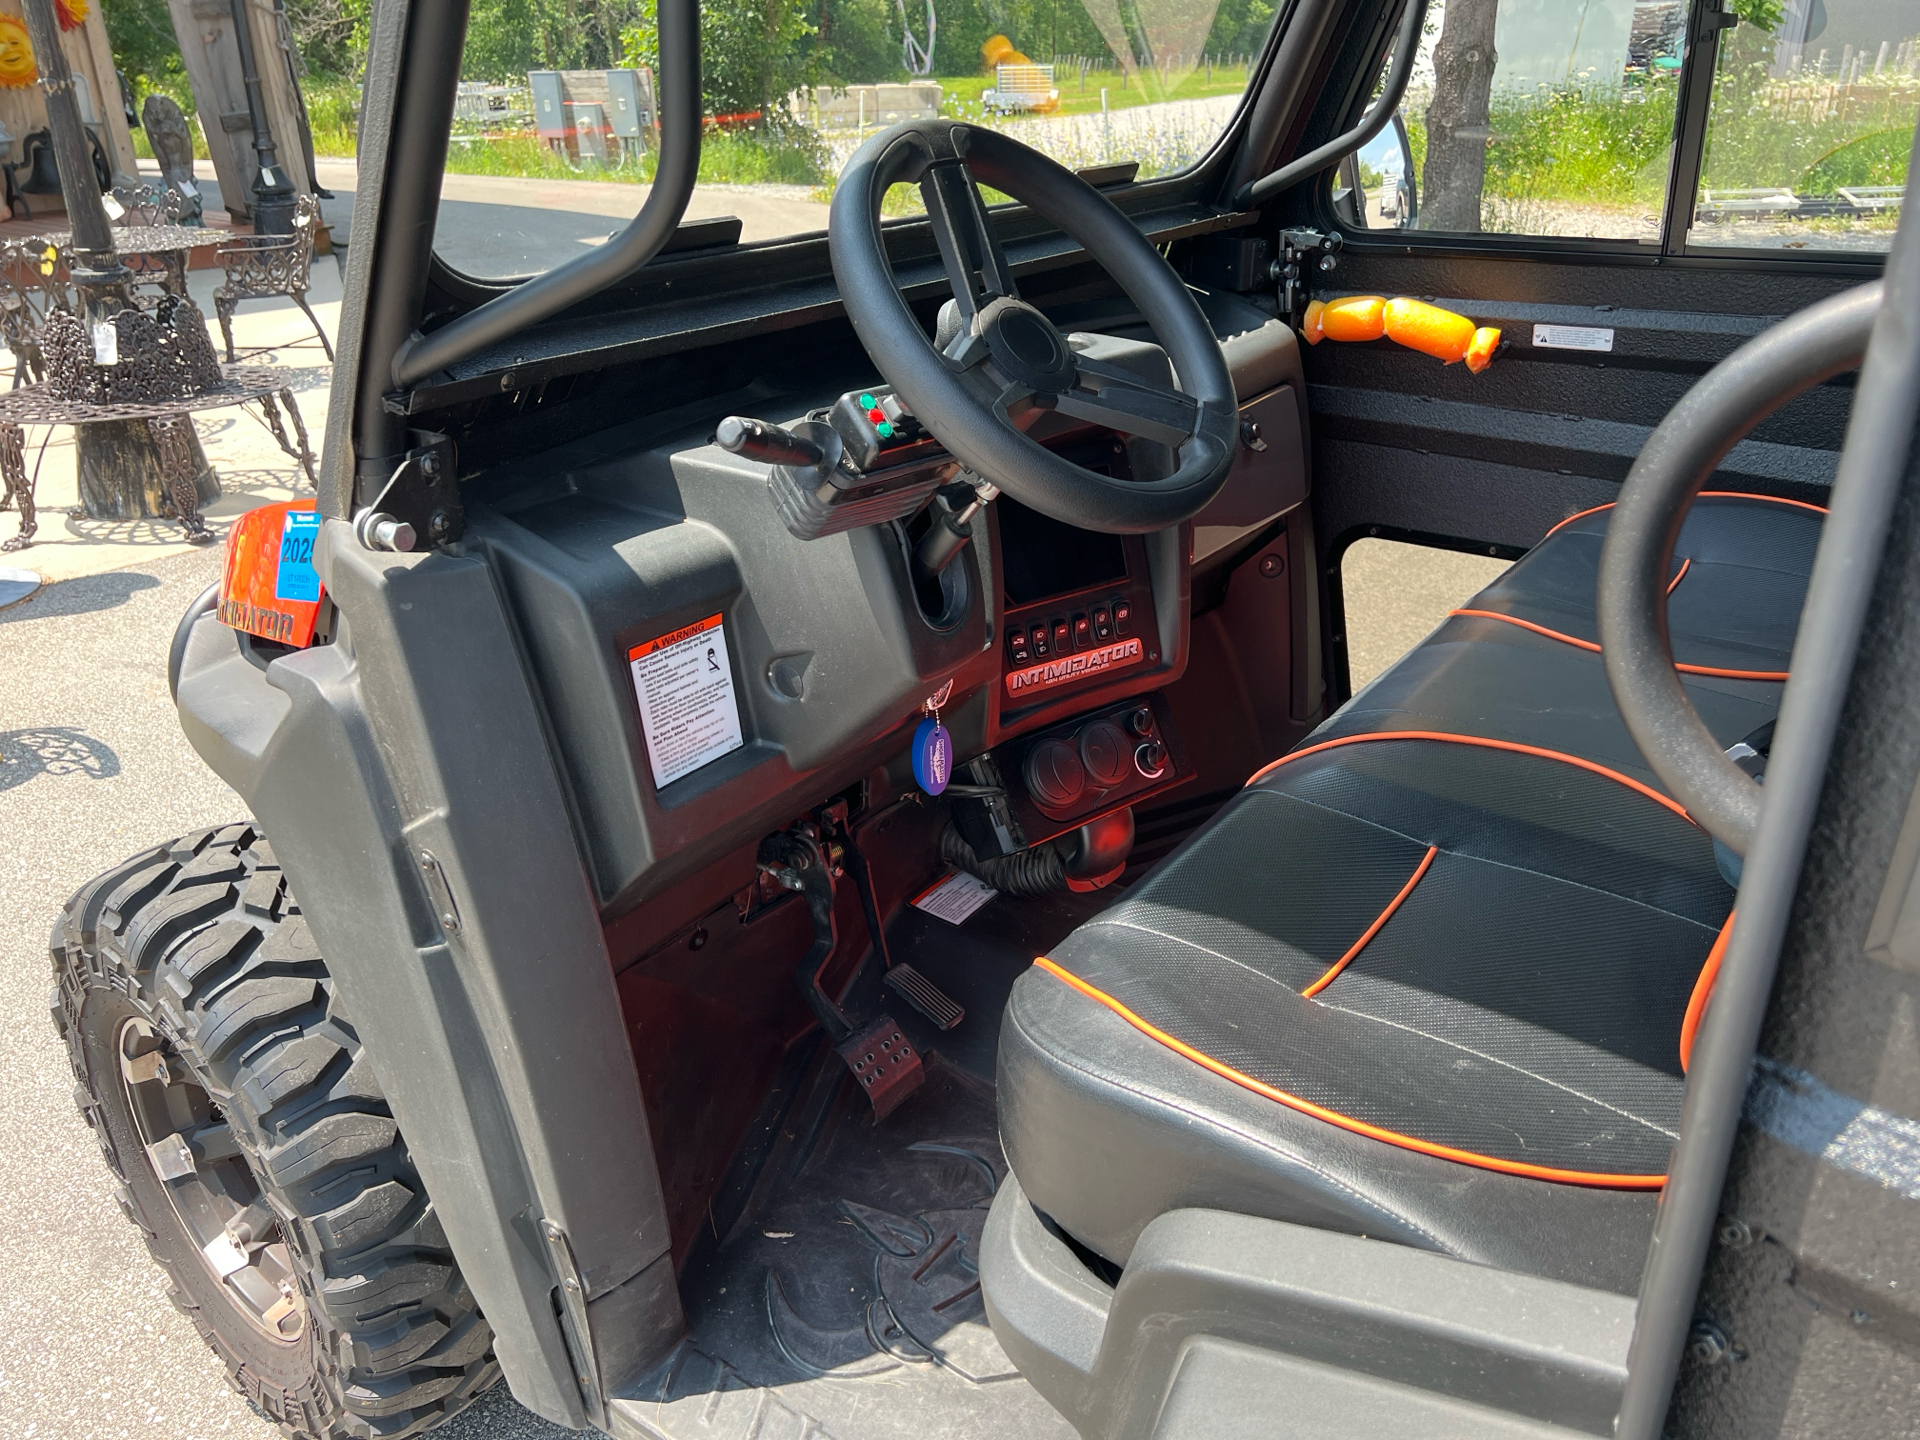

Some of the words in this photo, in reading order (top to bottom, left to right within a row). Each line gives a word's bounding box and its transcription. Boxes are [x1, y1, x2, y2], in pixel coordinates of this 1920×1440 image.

[662, 623, 705, 646] WARNING
[638, 653, 659, 664] Improper
[676, 636, 701, 649] Off-Highway
[703, 628, 720, 638] Vehicles
[650, 658, 663, 666] Cause
[665, 651, 679, 660] Severe
[1012, 641, 1138, 690] INTIMIDATOR
[648, 664, 668, 675] Prepared
[1059, 672, 1081, 682] UTILITY
[1081, 663, 1110, 675] VEHICLES
[672, 722, 685, 731] Riders
[695, 708, 714, 720] Attention
[674, 727, 688, 736] Ahead
